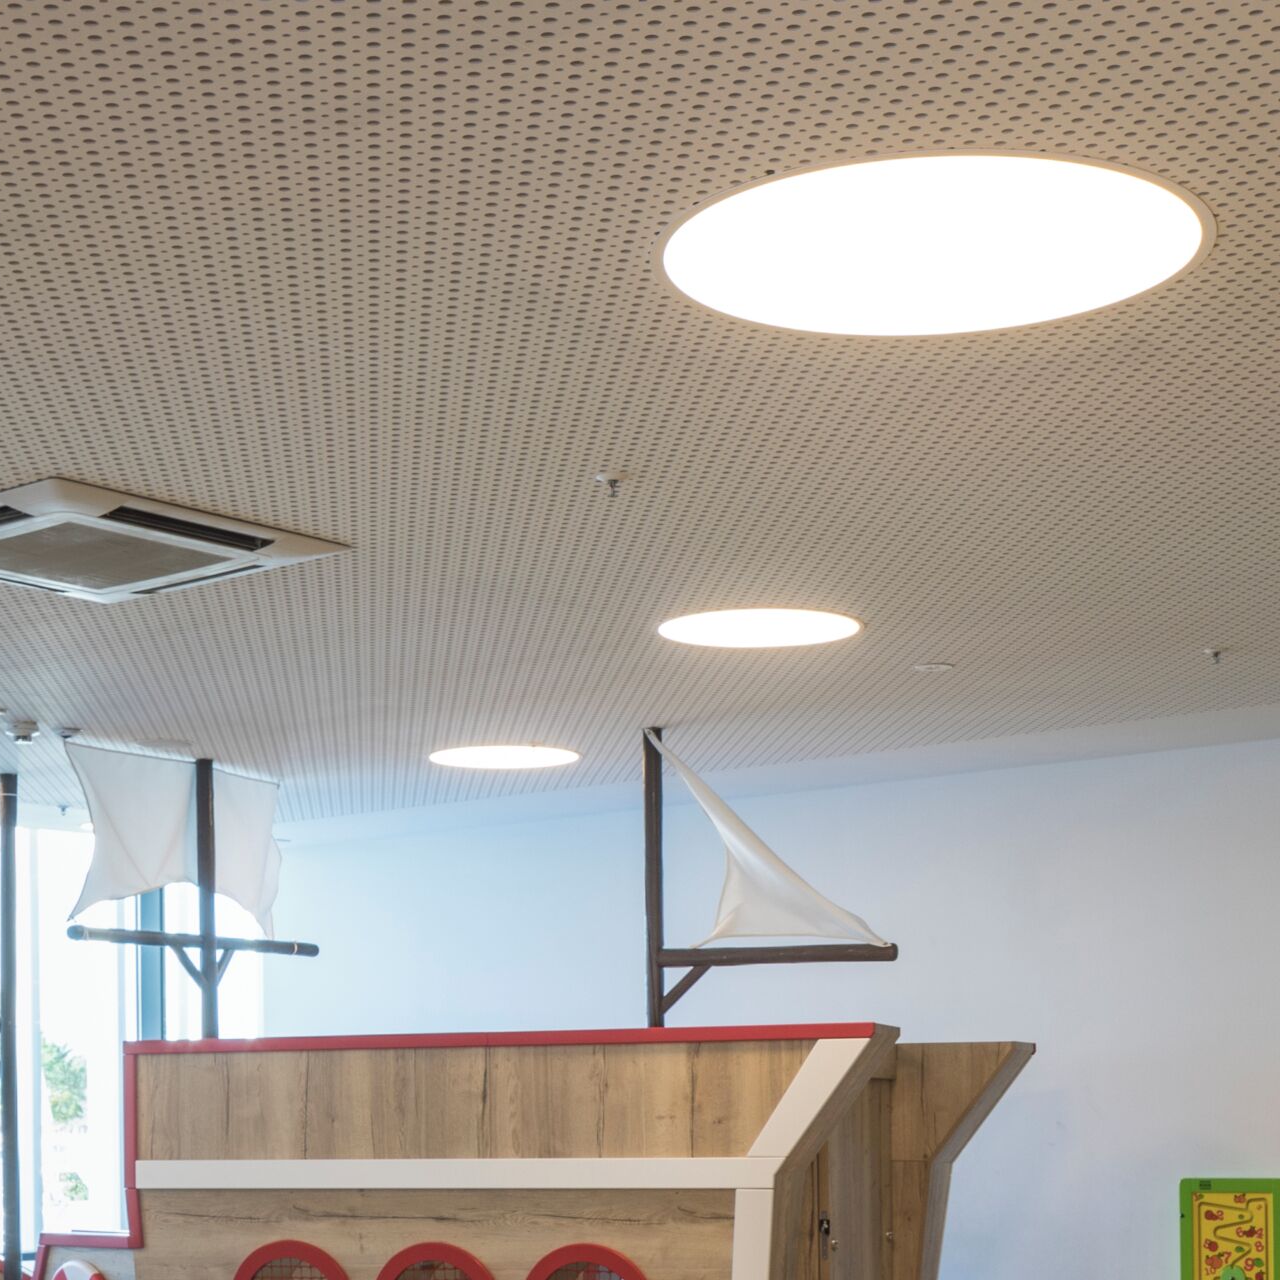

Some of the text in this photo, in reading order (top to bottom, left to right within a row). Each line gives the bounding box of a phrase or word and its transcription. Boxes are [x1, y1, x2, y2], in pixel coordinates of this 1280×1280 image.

[1255, 1241, 1265, 1252] 8
[1223, 1251, 1232, 1264] 7
[1244, 1257, 1254, 1272] 9
